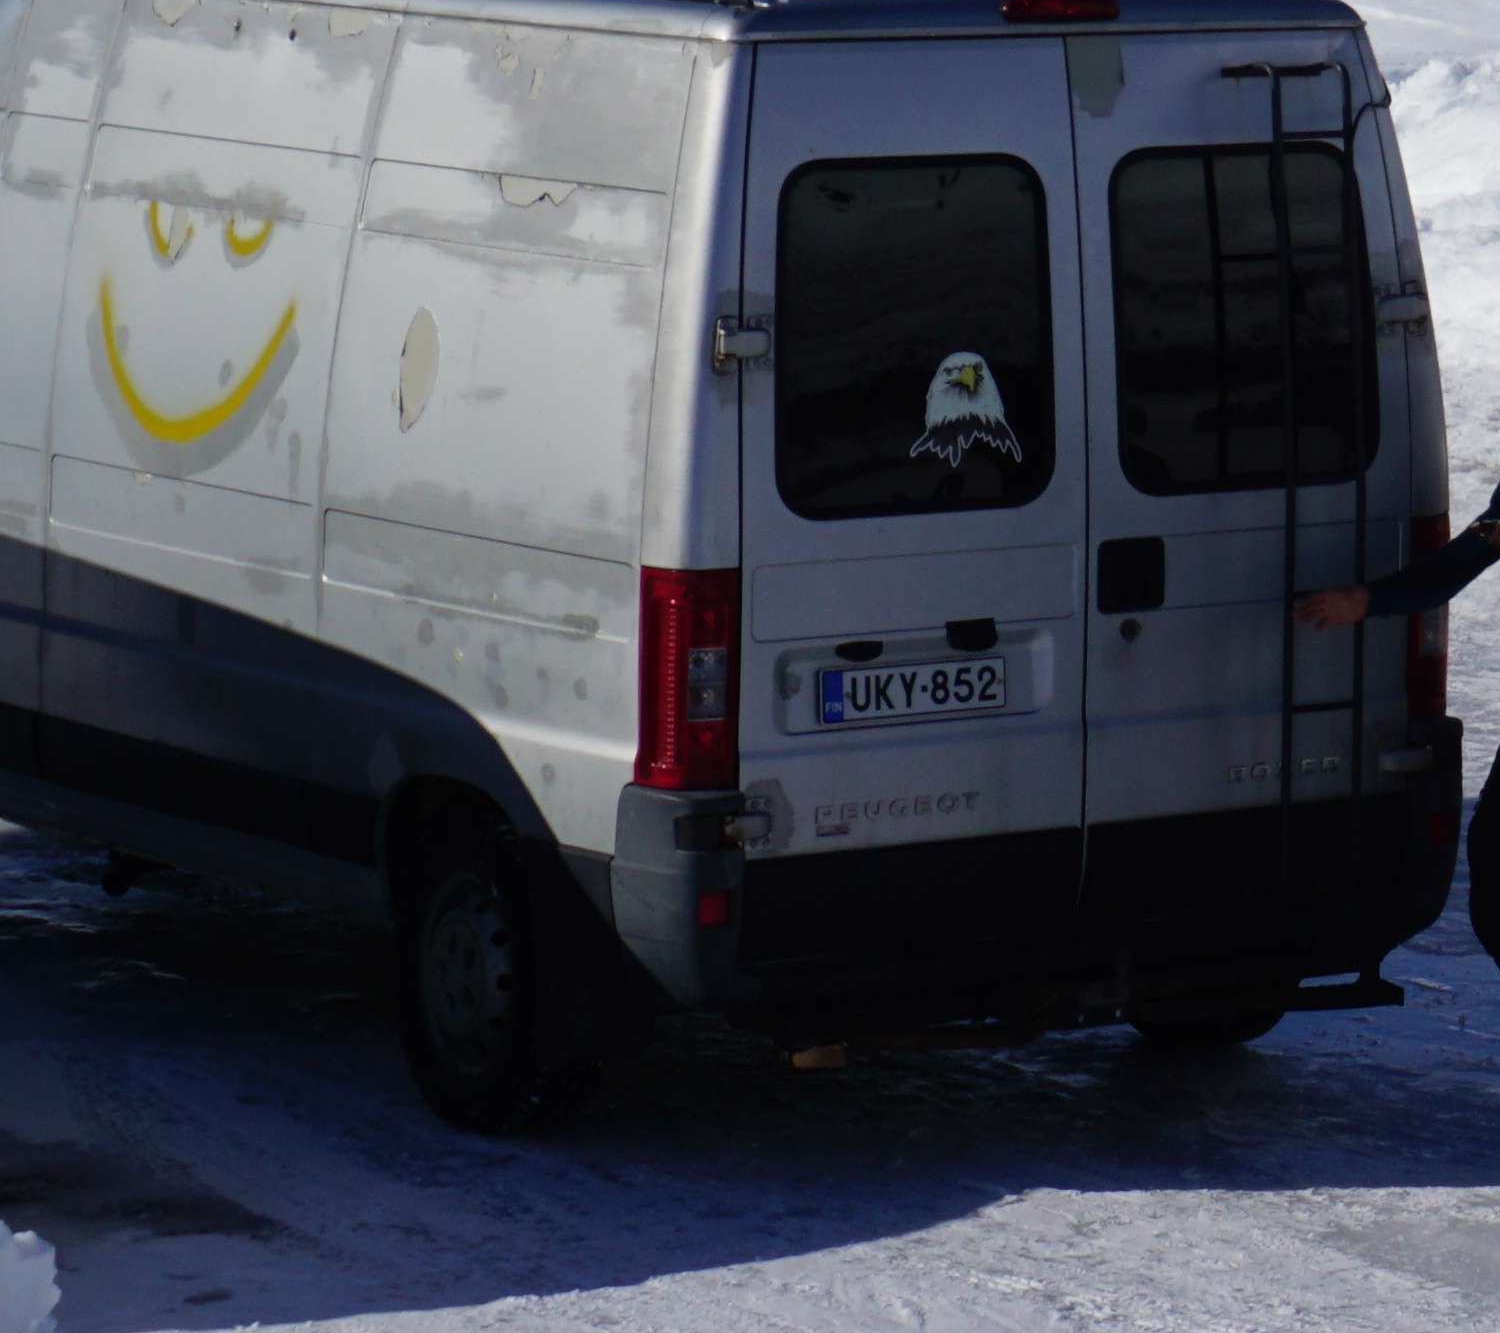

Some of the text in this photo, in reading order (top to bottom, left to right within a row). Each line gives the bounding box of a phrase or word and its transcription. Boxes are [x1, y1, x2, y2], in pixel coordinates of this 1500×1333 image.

[850, 665, 997, 712] UKY-852
[825, 701, 843, 713] FIN
[814, 790, 980, 824] PEUGEOT
